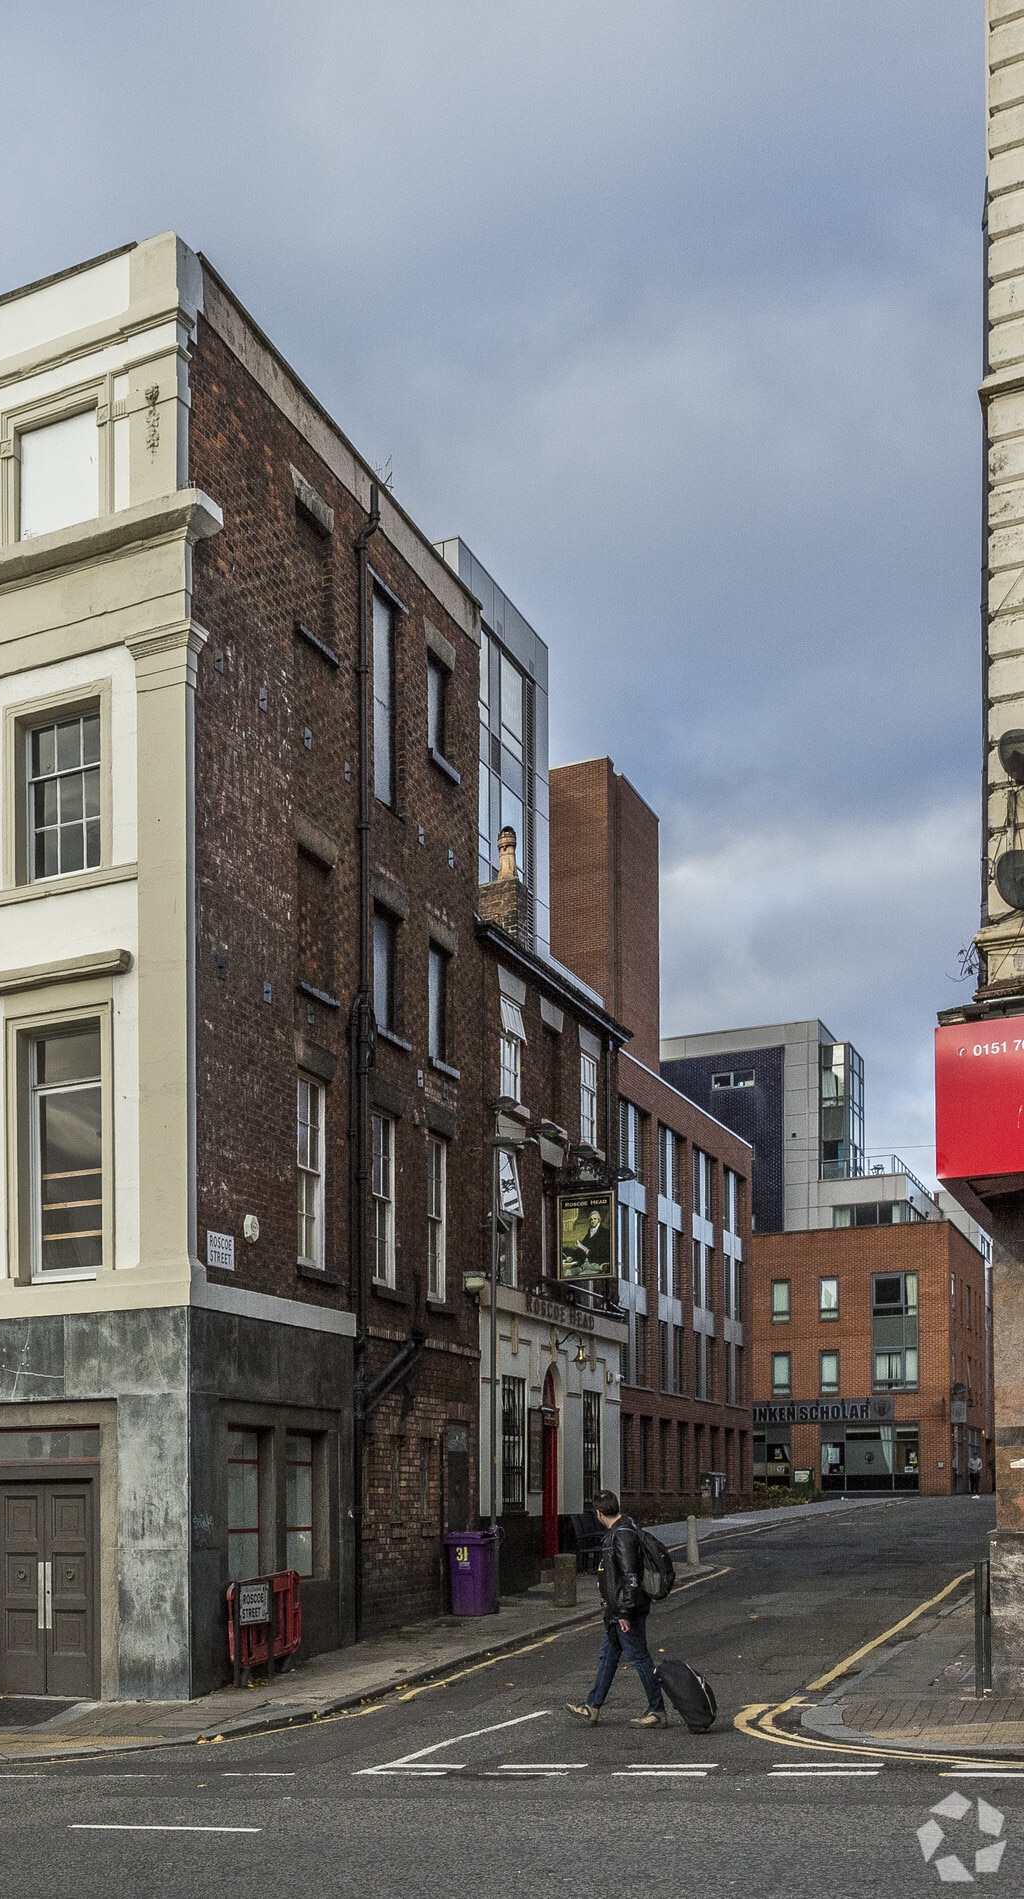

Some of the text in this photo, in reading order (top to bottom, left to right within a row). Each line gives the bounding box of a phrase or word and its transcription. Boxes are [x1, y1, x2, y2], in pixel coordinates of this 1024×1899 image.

[972, 1041, 1007, 1057] 0151
[209, 1235, 232, 1251] ROSCOE
[209, 1249, 232, 1266] STREET
[525, 1294, 595, 1331] ROSCOE HEAD
[799, 1403, 871, 1421] SCHOLAR
[456, 1546, 469, 1562] 31
[243, 1593, 264, 1604] ROSCOE
[242, 1607, 261, 1618] STREET
